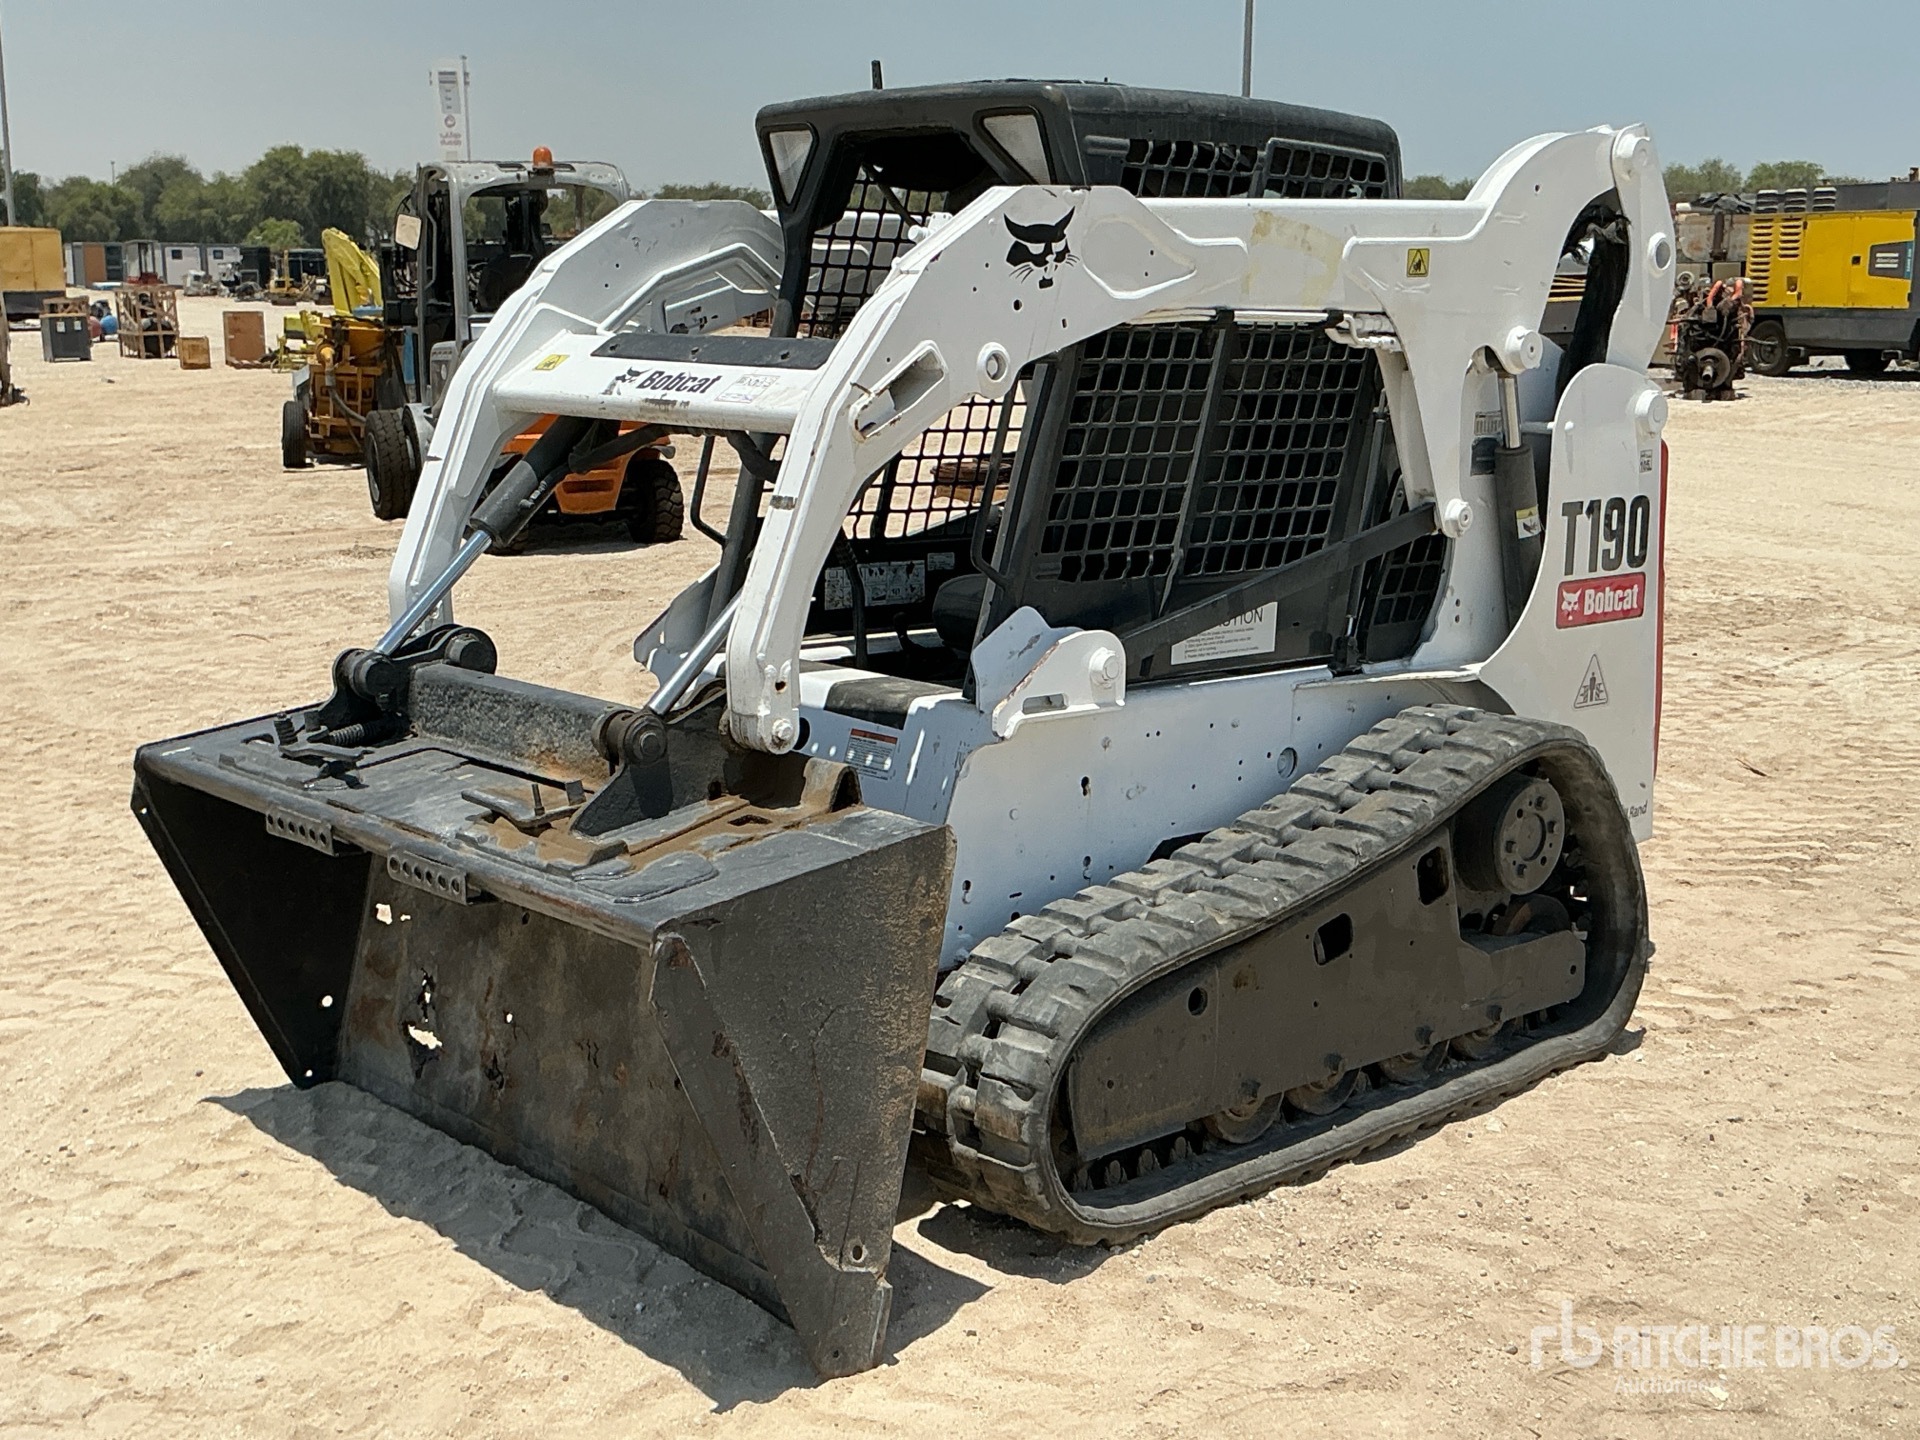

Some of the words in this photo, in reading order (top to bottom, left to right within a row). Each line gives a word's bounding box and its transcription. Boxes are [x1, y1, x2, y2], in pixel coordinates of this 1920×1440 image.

[636, 370, 722, 394] Bobcat
[1561, 494, 1650, 576] T190
[1583, 583, 1639, 616] Bobcat
